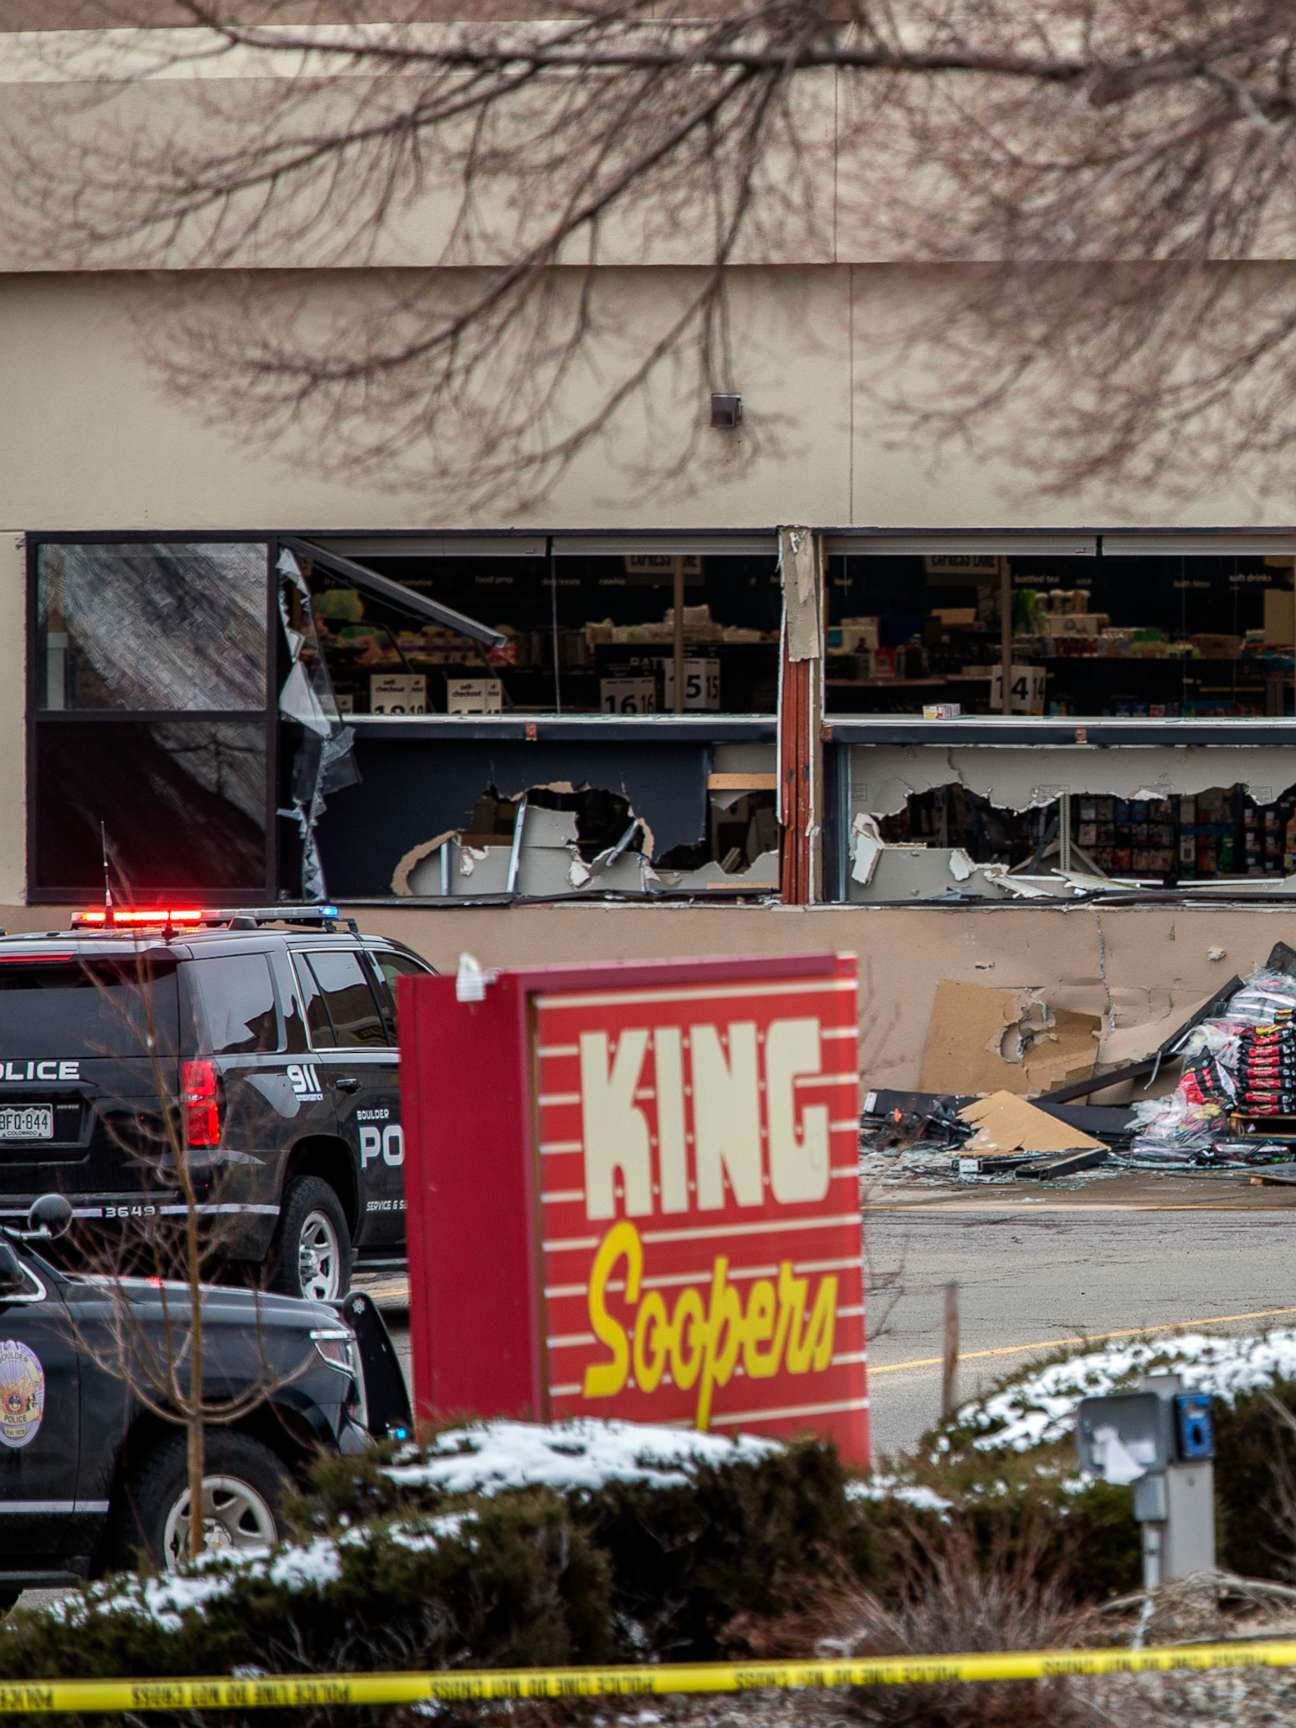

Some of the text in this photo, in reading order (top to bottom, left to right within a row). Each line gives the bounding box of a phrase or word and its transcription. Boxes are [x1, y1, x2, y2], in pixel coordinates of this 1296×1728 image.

[0, 1061, 80, 1080] LICE
[287, 1064, 321, 1092] 911
[356, 1109, 390, 1121] BOULDER
[579, 1017, 831, 1221] KING
[105, 1206, 156, 1218] 3649
[366, 1200, 391, 1212] SERVICE
[582, 1220, 838, 1432] Soopers
[4, 1414, 27, 1424] POLICE
